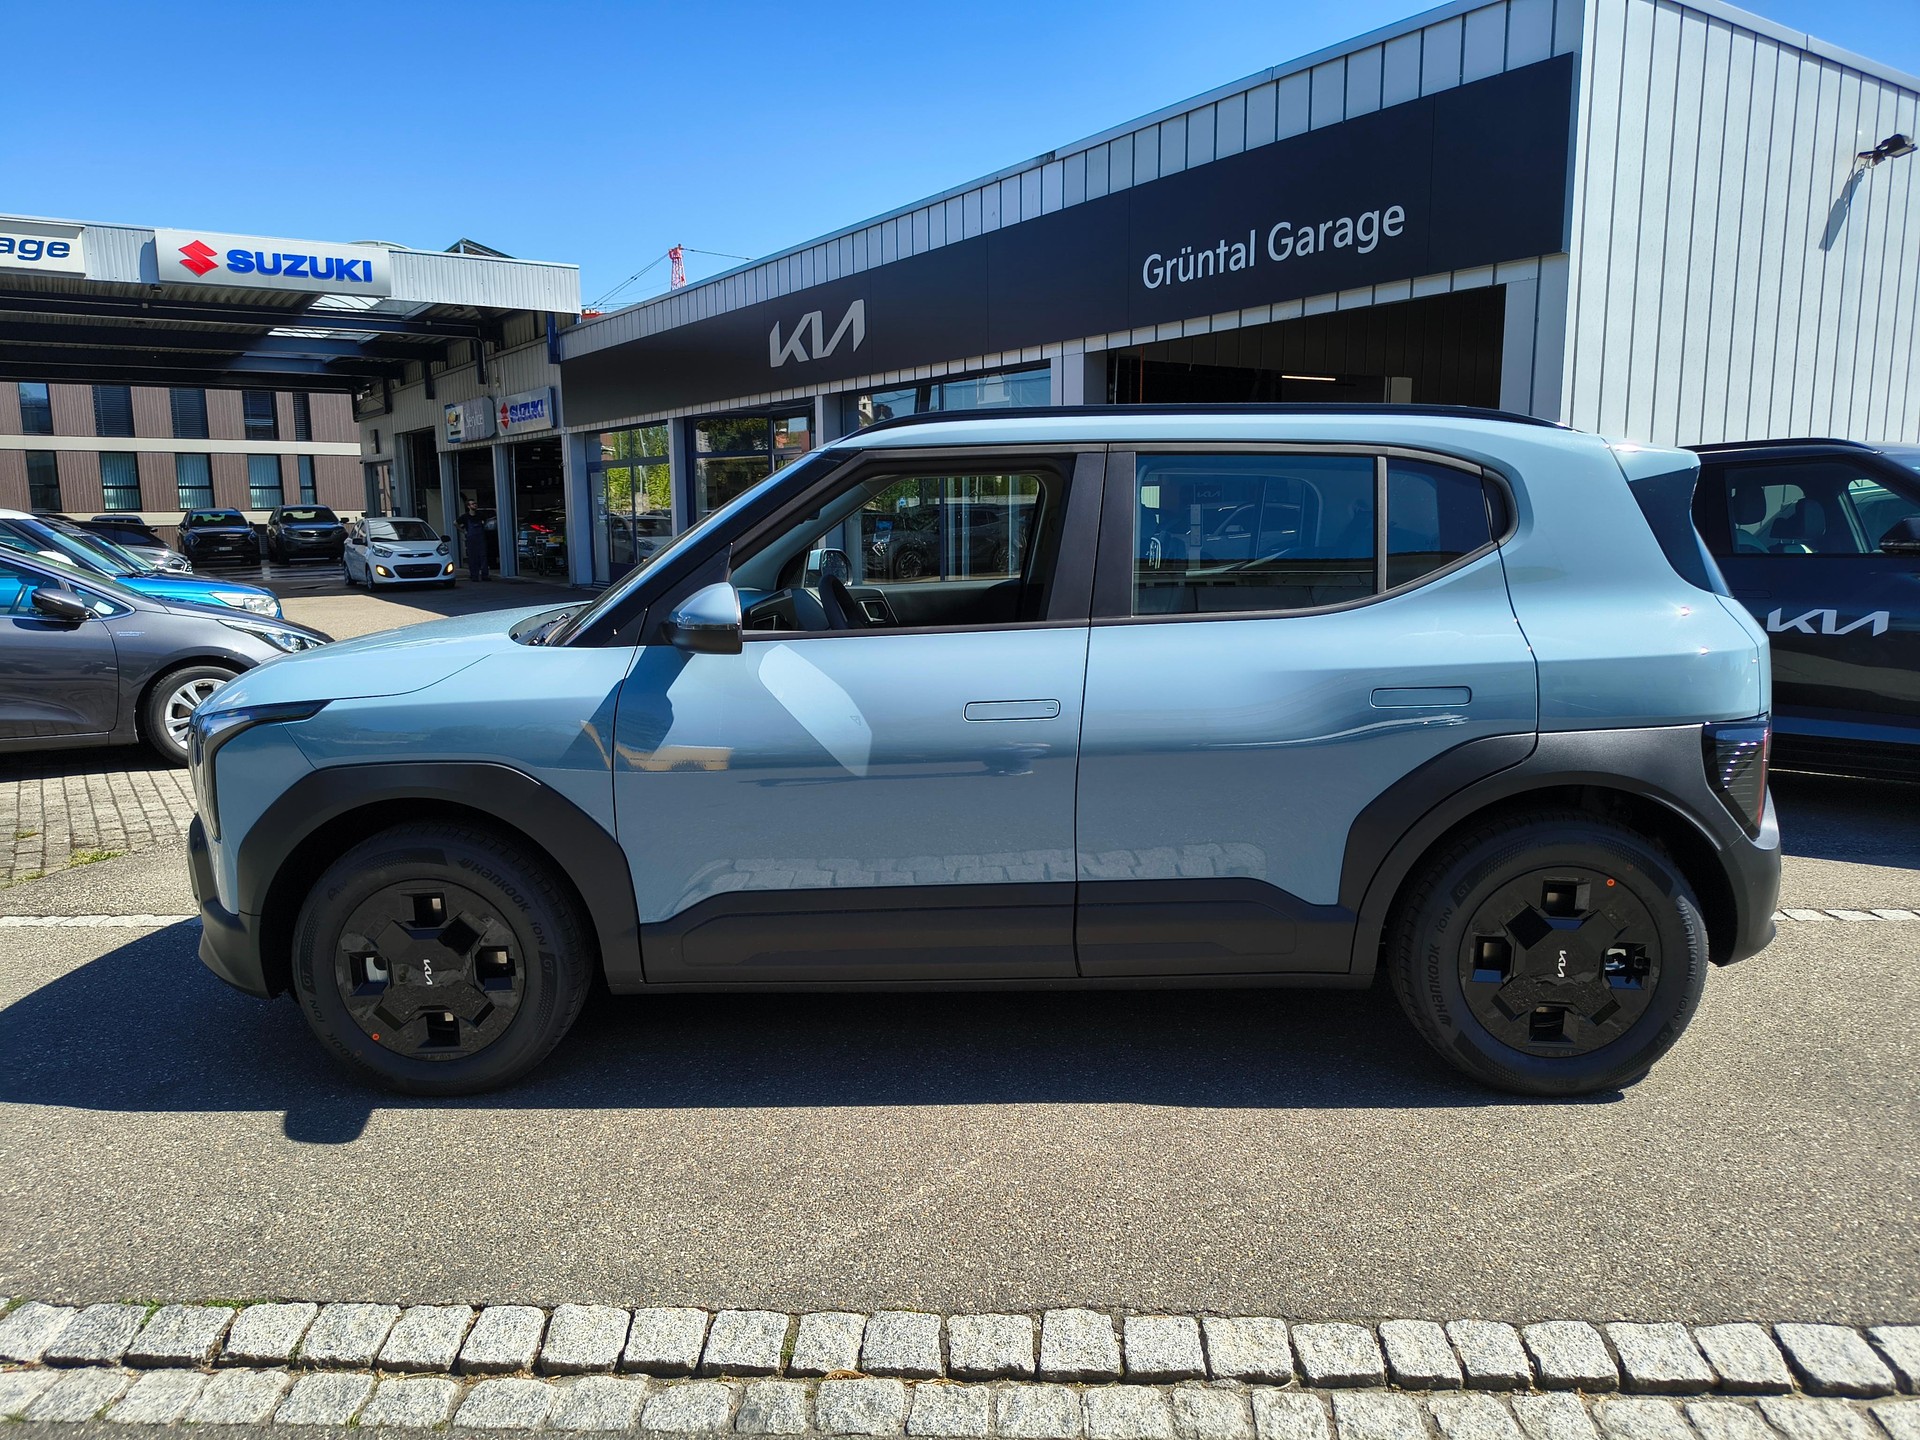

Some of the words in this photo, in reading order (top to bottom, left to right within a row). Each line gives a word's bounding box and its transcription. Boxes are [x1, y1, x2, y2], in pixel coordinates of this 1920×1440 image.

[1142, 229, 1256, 289] Grüntal
[1267, 205, 1406, 262] Garage
[226, 249, 373, 283] SUZUKI
[769, 299, 866, 368] KIA
[509, 399, 545, 423] SUZUKI
[1766, 607, 1890, 637] KIA
[423, 959, 433, 986] KIA
[1558, 950, 1567, 978] KIA
